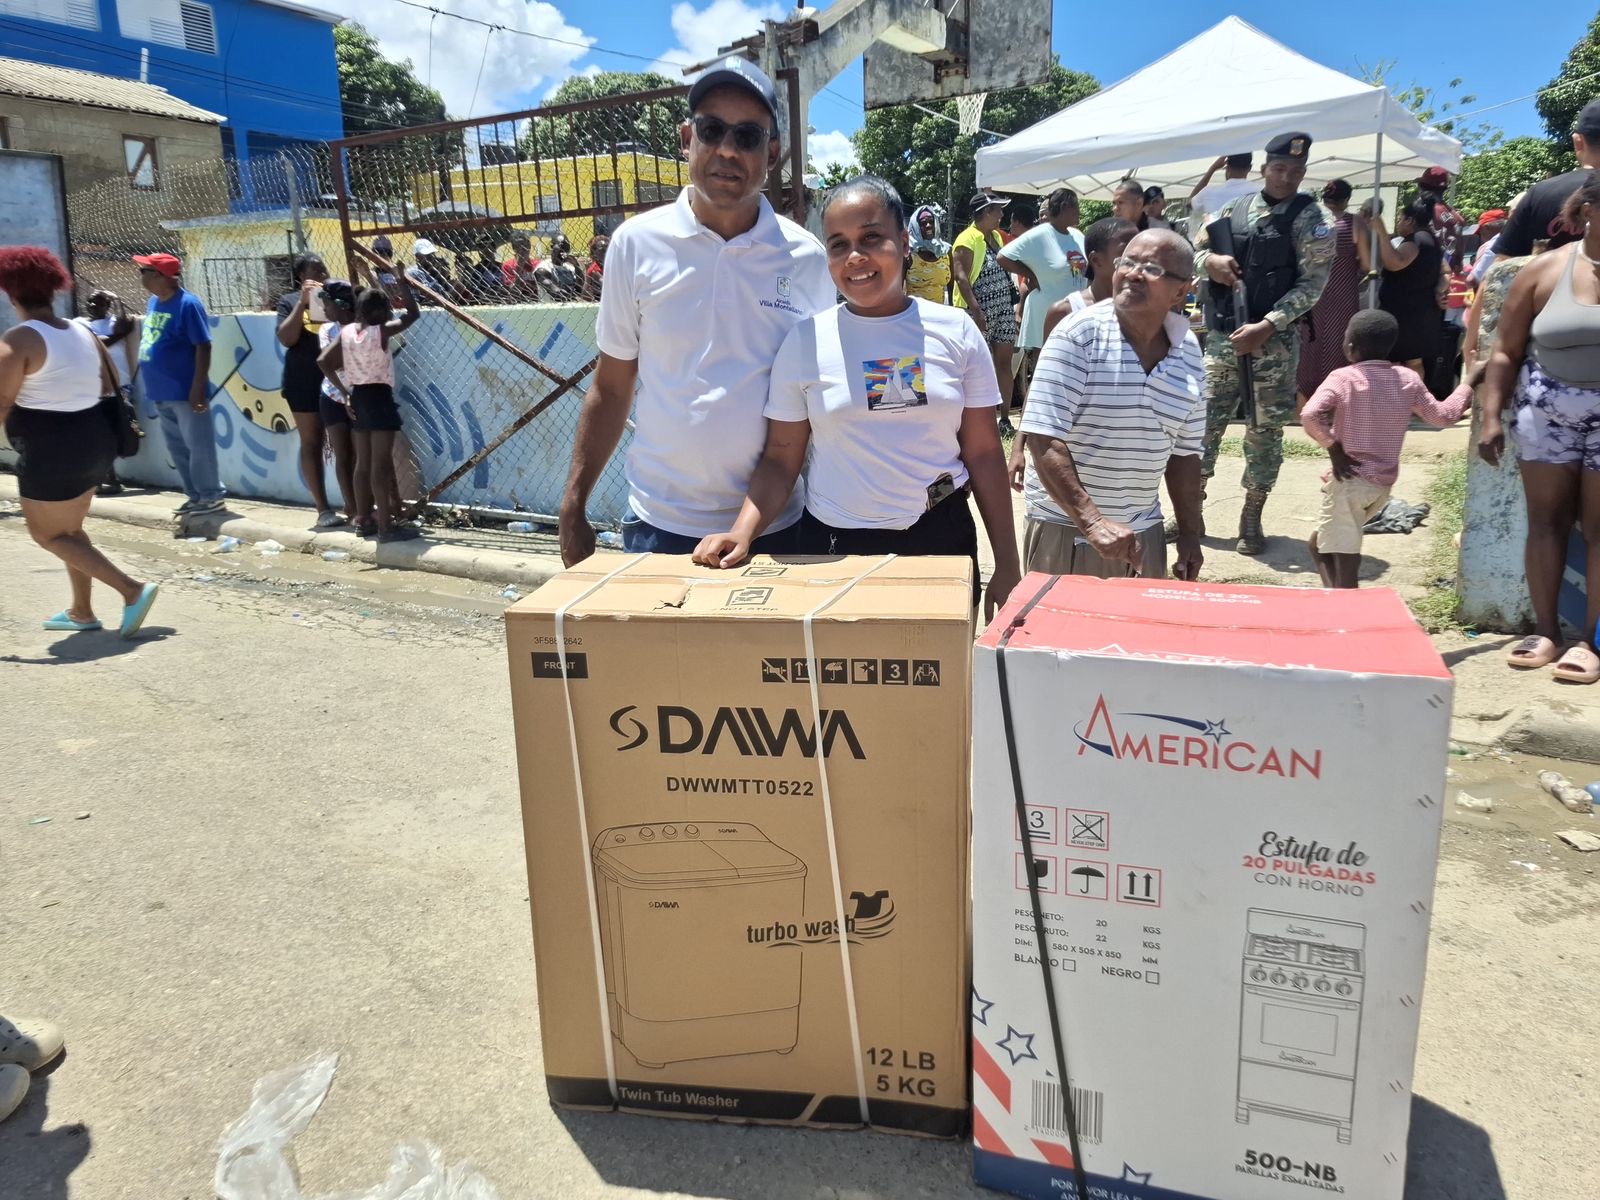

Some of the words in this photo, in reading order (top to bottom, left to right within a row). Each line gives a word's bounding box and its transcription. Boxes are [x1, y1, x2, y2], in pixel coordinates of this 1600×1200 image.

[759, 300, 773, 308] Villa
[544, 661, 576, 670] FRONT
[1076, 694, 1322, 780] AMERICAN
[666, 776, 815, 797] DWWMTT0522
[1030, 810, 1044, 828] 3
[1258, 831, 1331, 868] Estufa
[1336, 841, 1370, 867] de
[1242, 855, 1266, 869] 20
[1272, 859, 1376, 884] PULGADAS
[1254, 872, 1292, 887] CON
[1298, 878, 1365, 897] HORNO
[747, 920, 798, 943] turbo
[1014, 923, 1037, 933] PESO
[1041, 926, 1069, 937] RUTO:
[1096, 934, 1107, 942] 22
[1142, 941, 1161, 950] KGS
[1096, 919, 1107, 927] 20
[1143, 925, 1161, 935] KGS
[1014, 937, 1033, 947] DIM:
[1053, 943, 1069, 952] 580
[1079, 947, 1095, 956] 505
[1105, 950, 1122, 960] 850
[1142, 956, 1158, 965] MM
[1014, 953, 1059, 967] BLANO
[1101, 966, 1142, 979] NEGRO
[866, 1047, 893, 1066] 12
[903, 1051, 936, 1070] LB
[876, 1074, 890, 1092] 5
[899, 1077, 937, 1098] KG
[619, 1087, 651, 1102] Twin
[655, 1090, 681, 1105] Tub
[685, 1093, 740, 1108] Washer
[1244, 1149, 1337, 1182] 500-NB
[1051, 1177, 1073, 1191] POR
[1281, 1174, 1345, 1193] ESMALTADAS
